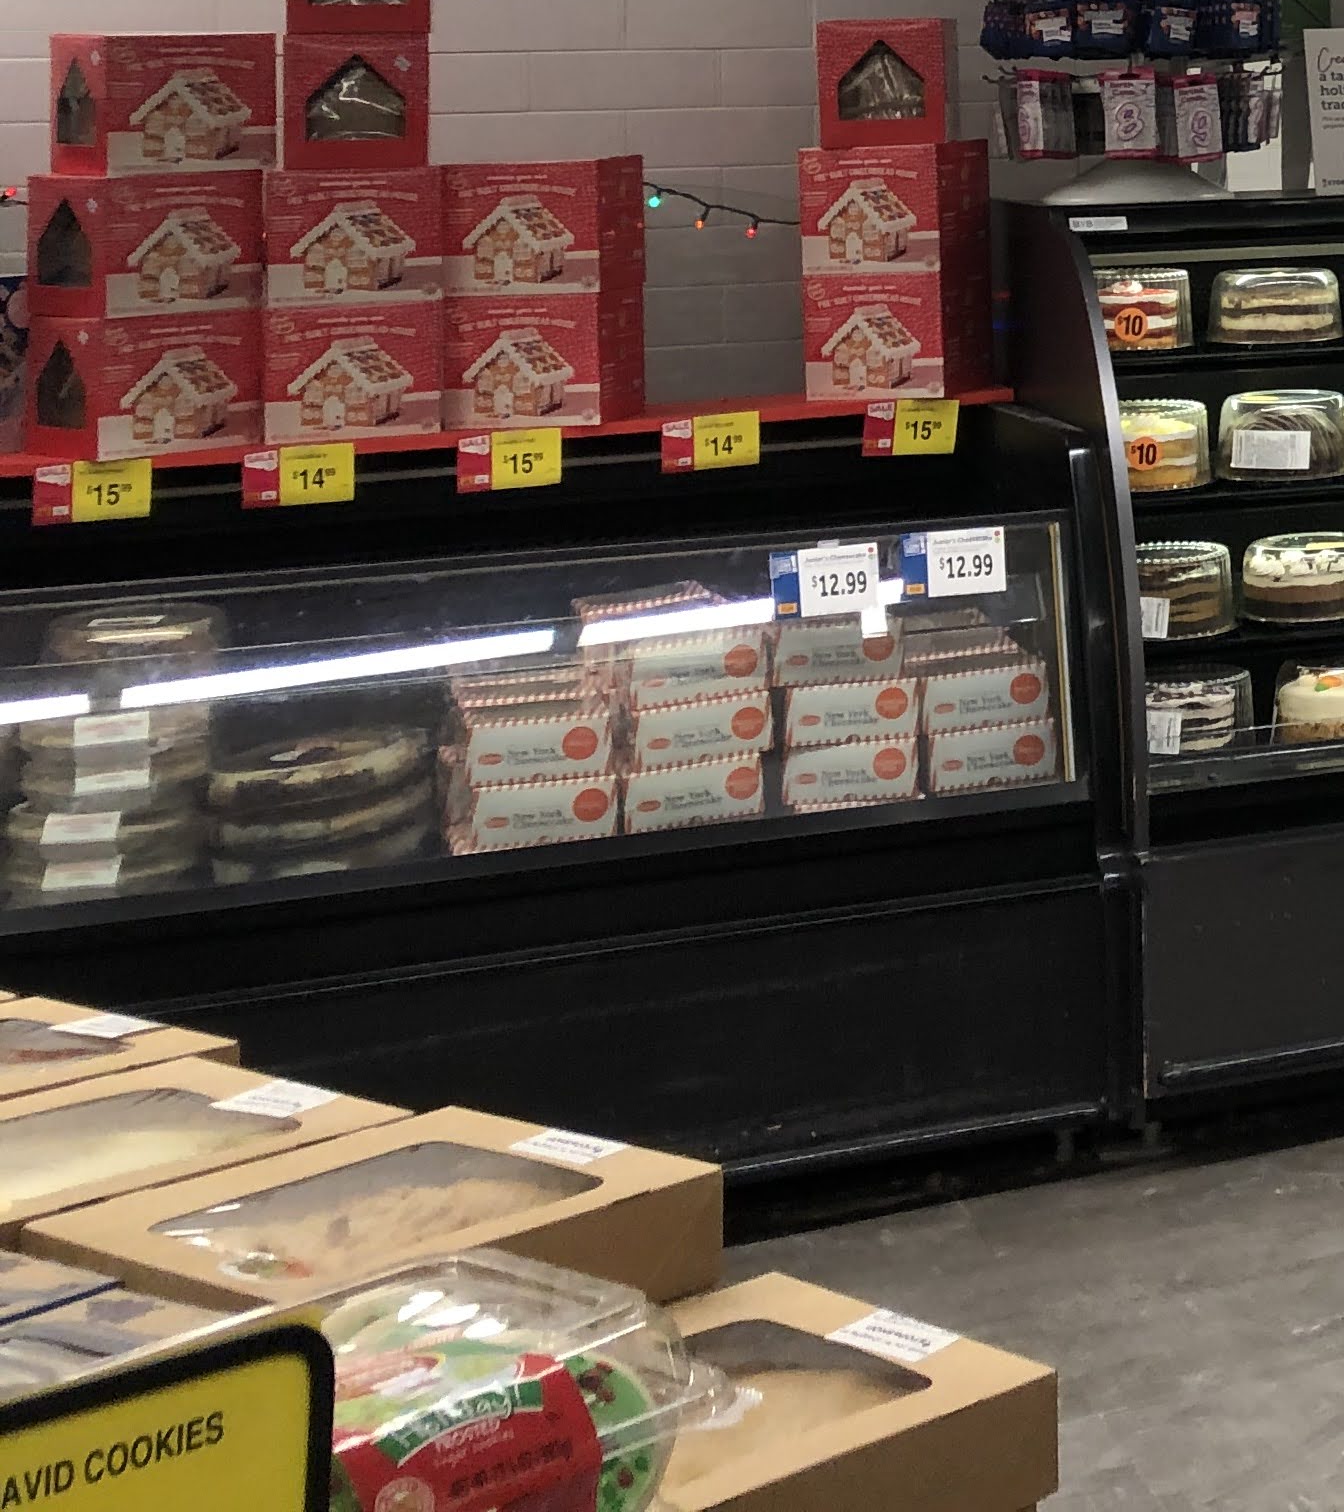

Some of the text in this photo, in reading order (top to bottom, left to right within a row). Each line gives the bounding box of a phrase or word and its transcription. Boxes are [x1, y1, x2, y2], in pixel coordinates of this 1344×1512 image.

[1318, 72, 1327, 82] a
[939, 553, 993, 579] $12.99
[811, 570, 868, 597] $12.99
[82, 1410, 226, 1483] COOKIES
